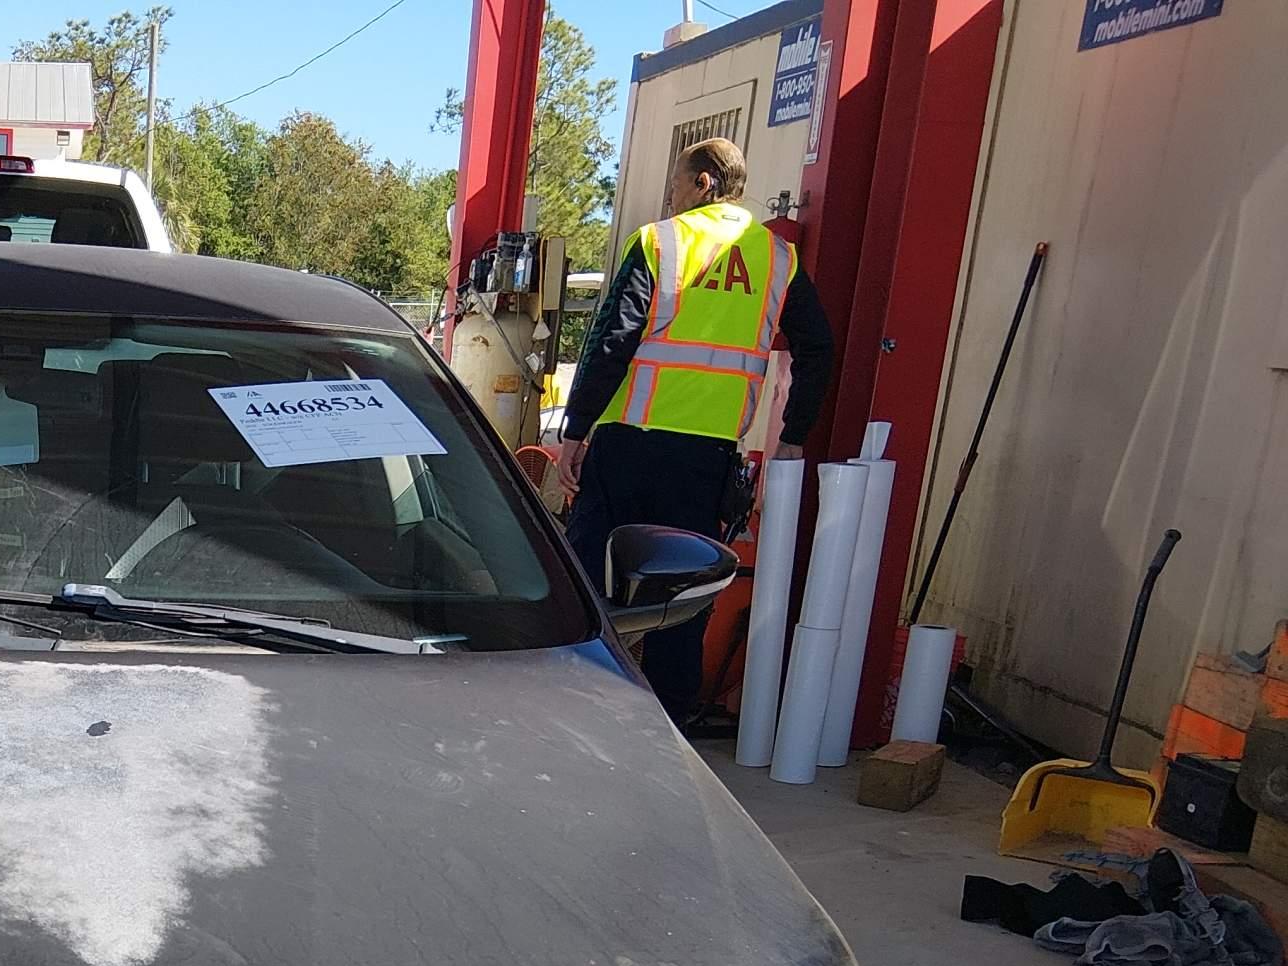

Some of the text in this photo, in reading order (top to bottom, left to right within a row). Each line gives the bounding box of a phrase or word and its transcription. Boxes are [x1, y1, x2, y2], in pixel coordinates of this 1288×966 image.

[1093, 0, 1204, 43] mobilemini.com
[777, 24, 816, 72] mobile
[245, 395, 384, 417] 44668534
